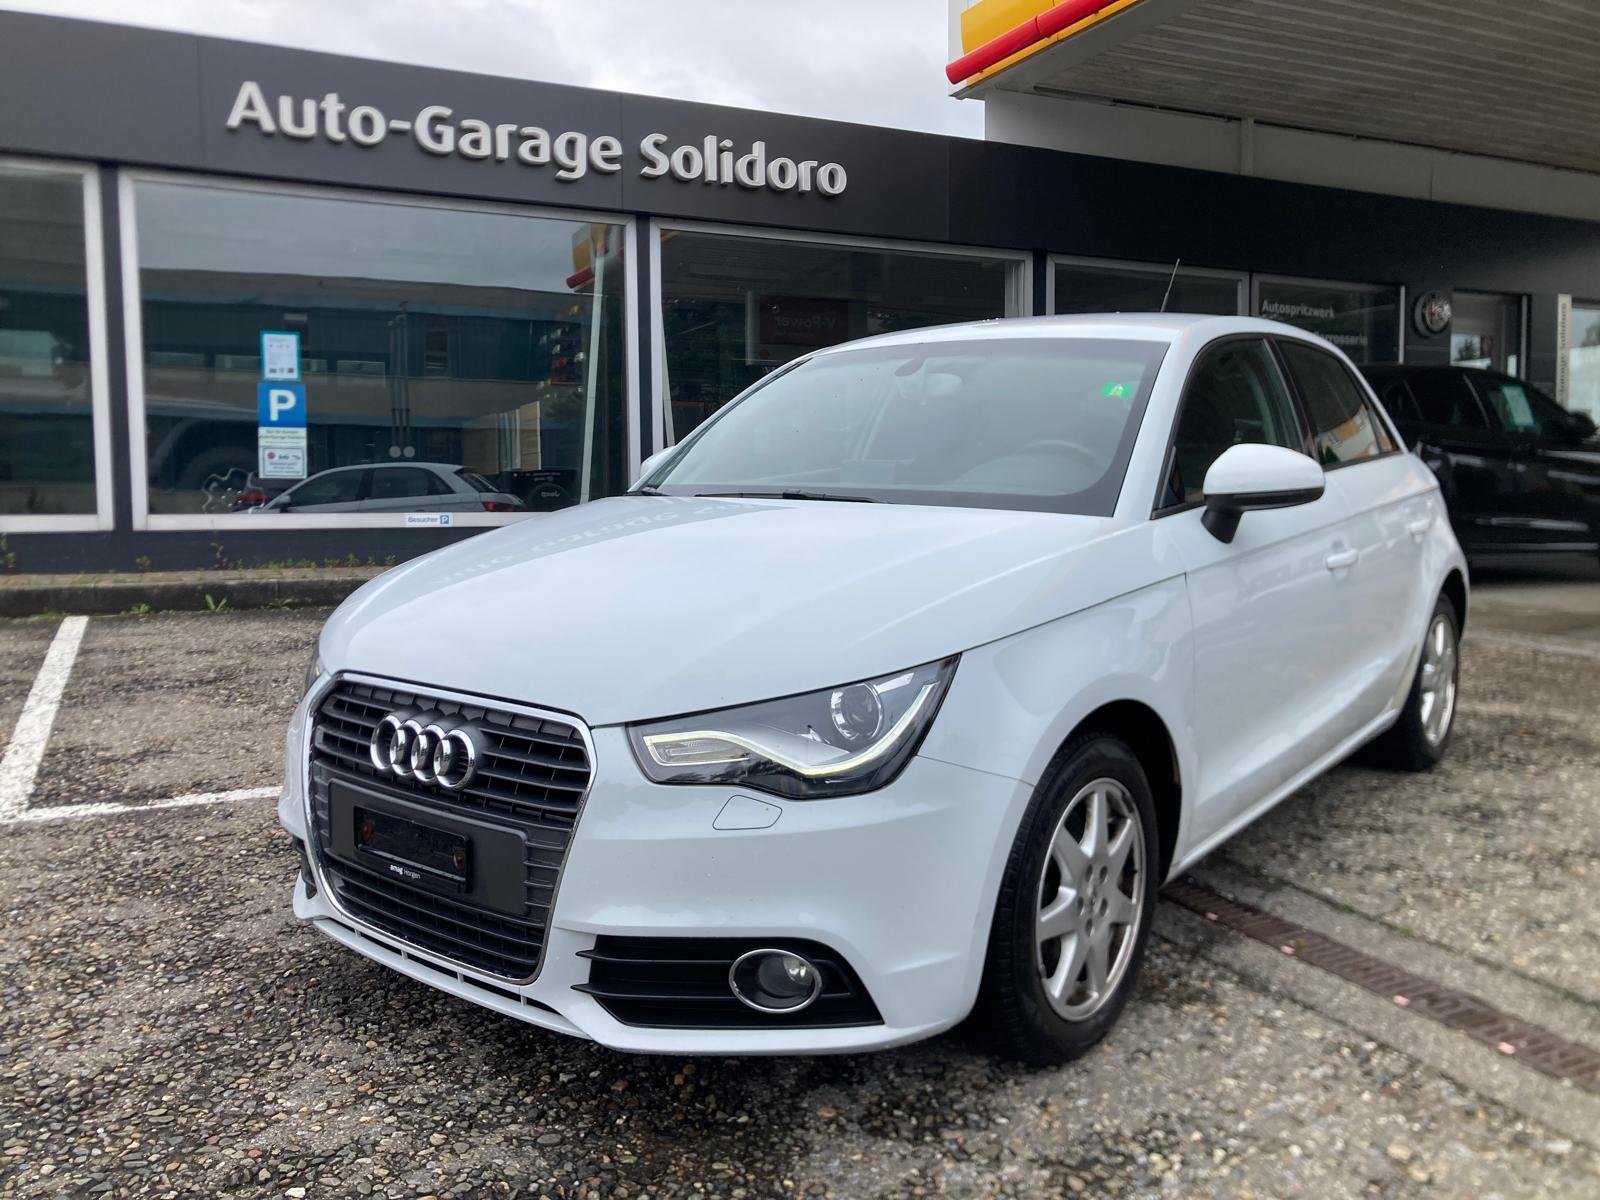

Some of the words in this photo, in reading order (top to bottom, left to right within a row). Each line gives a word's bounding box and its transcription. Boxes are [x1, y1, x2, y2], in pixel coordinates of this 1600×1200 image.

[226, 80, 623, 182] Auto-Garage
[640, 133, 848, 196] Solidoro
[1262, 300, 1335, 319] Autospritzwerk
[269, 389, 297, 421] P
[390, 864, 403, 875] amag
[404, 869, 421, 879] Horgen
